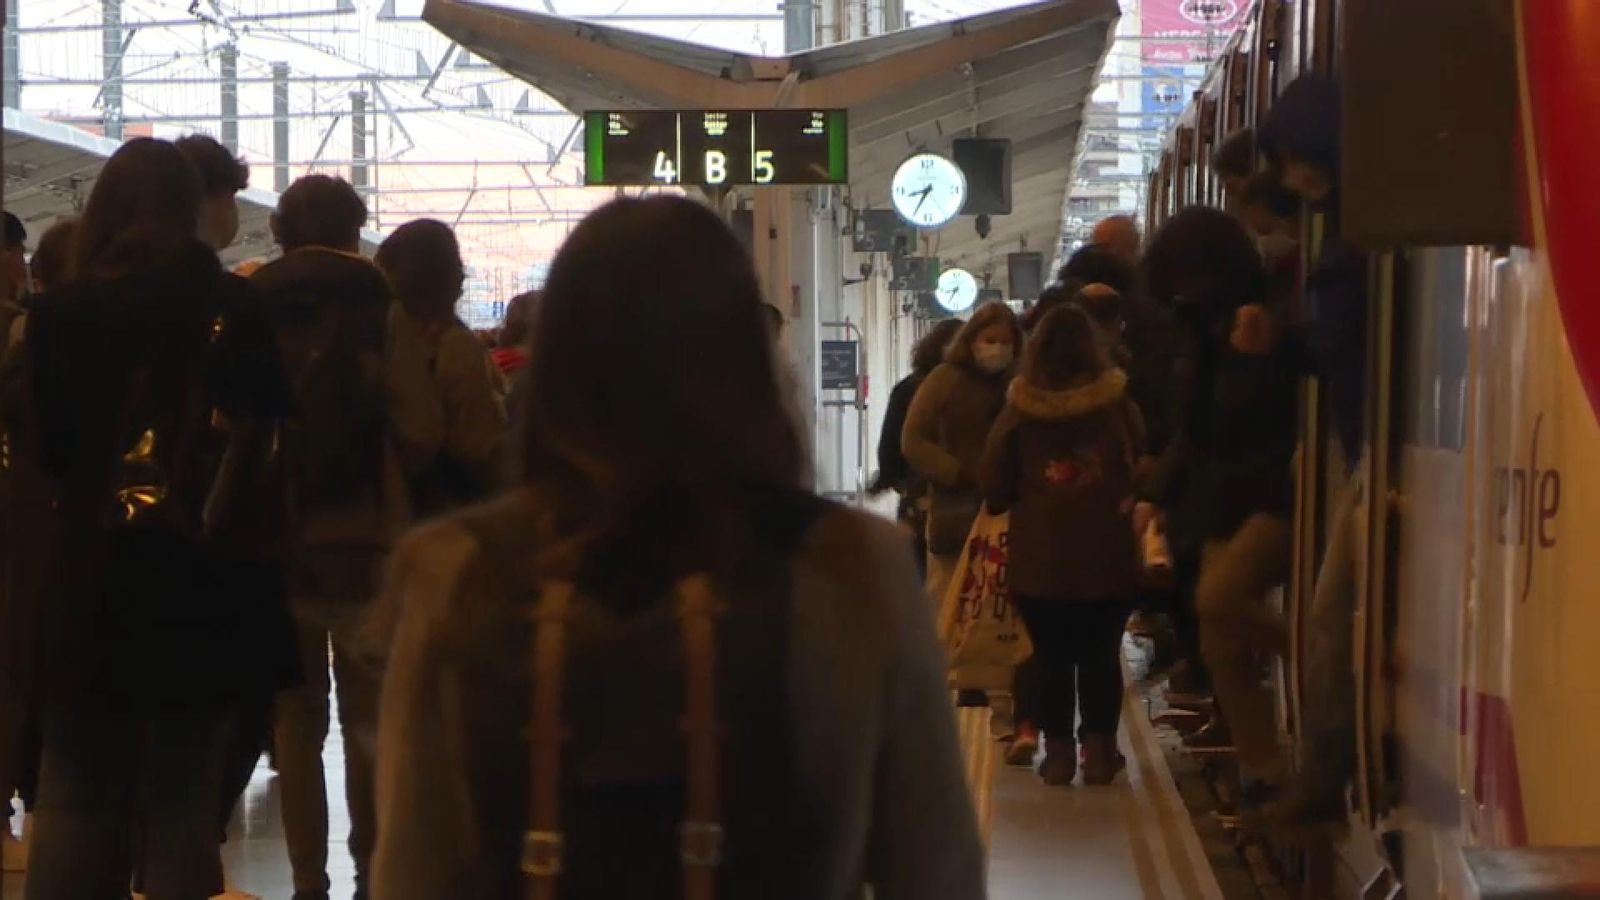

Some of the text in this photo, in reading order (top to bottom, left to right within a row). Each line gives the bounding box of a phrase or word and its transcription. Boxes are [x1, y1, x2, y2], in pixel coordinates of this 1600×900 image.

[654, 150, 774, 184] 4 B 5
[1492, 410, 1561, 603] enfe
